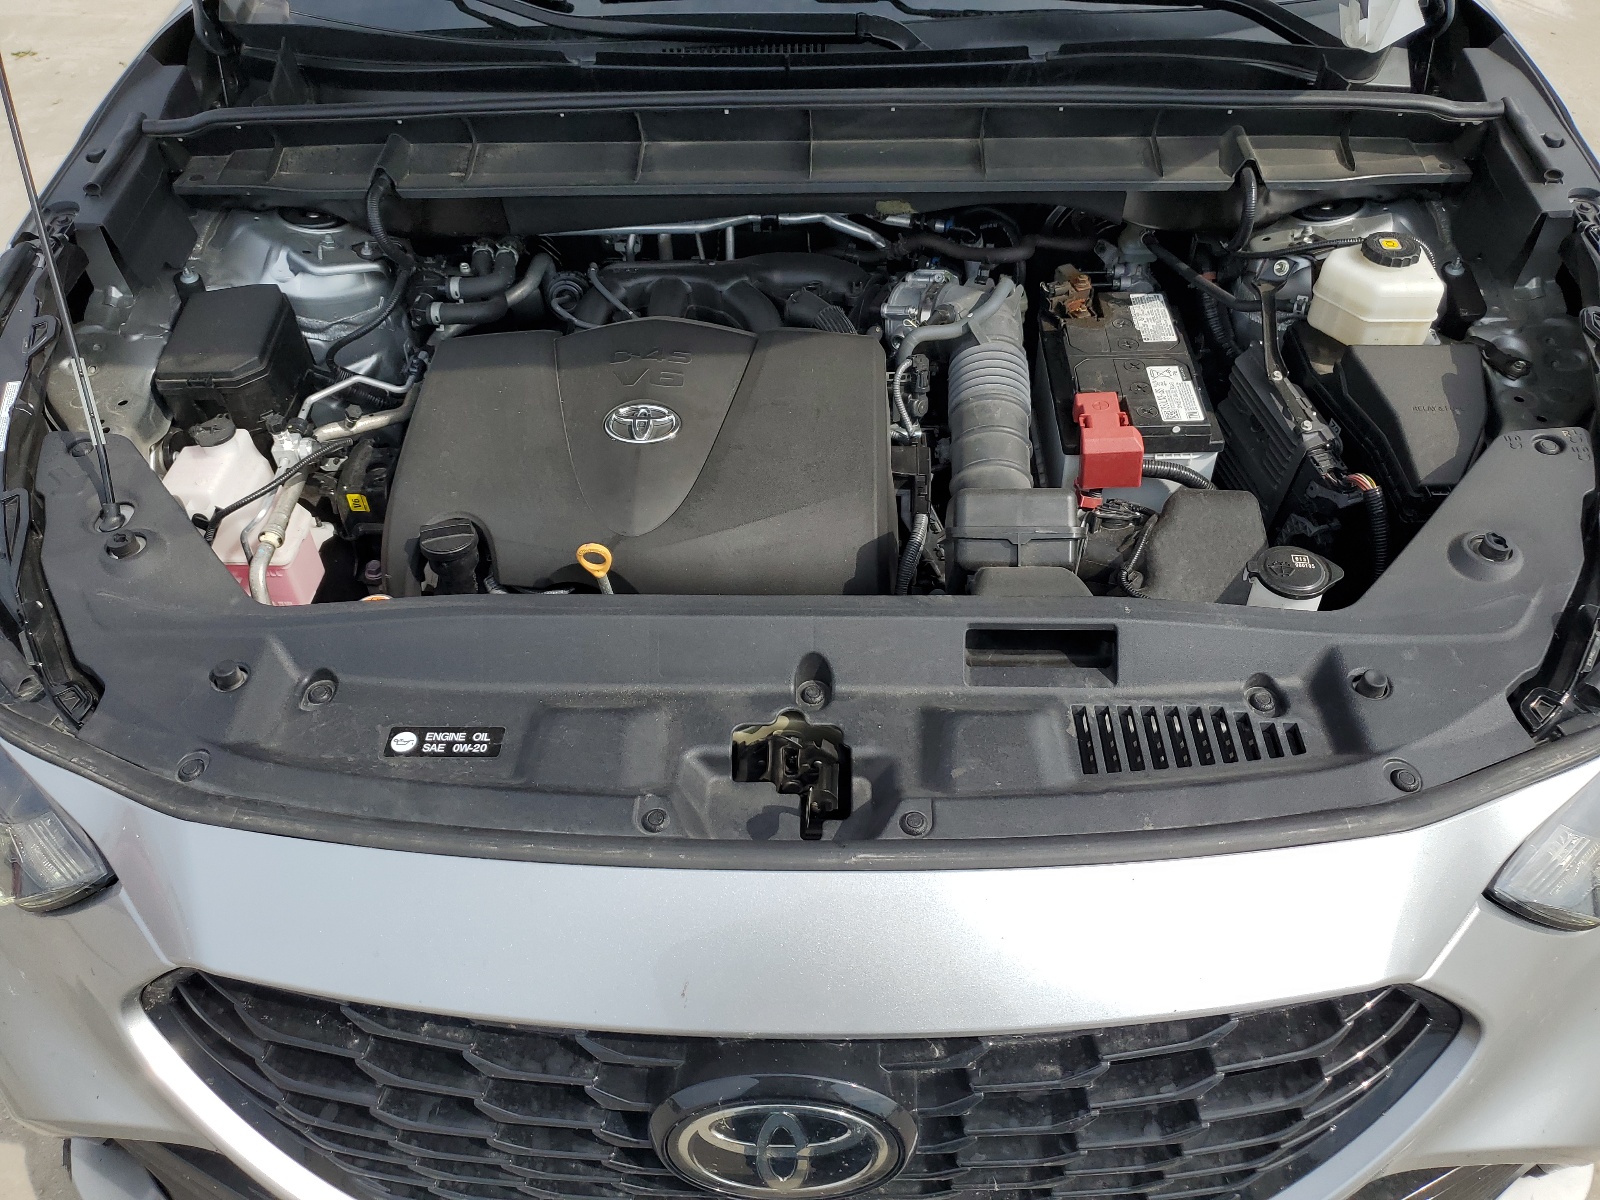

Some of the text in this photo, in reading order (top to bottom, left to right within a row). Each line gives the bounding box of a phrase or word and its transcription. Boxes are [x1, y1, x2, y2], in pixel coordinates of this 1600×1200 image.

[612, 368, 684, 388] V6
[352, 498, 362, 508] V6
[425, 732, 491, 742] ENGINE OIL
[422, 743, 488, 753] SAE 0W-20
